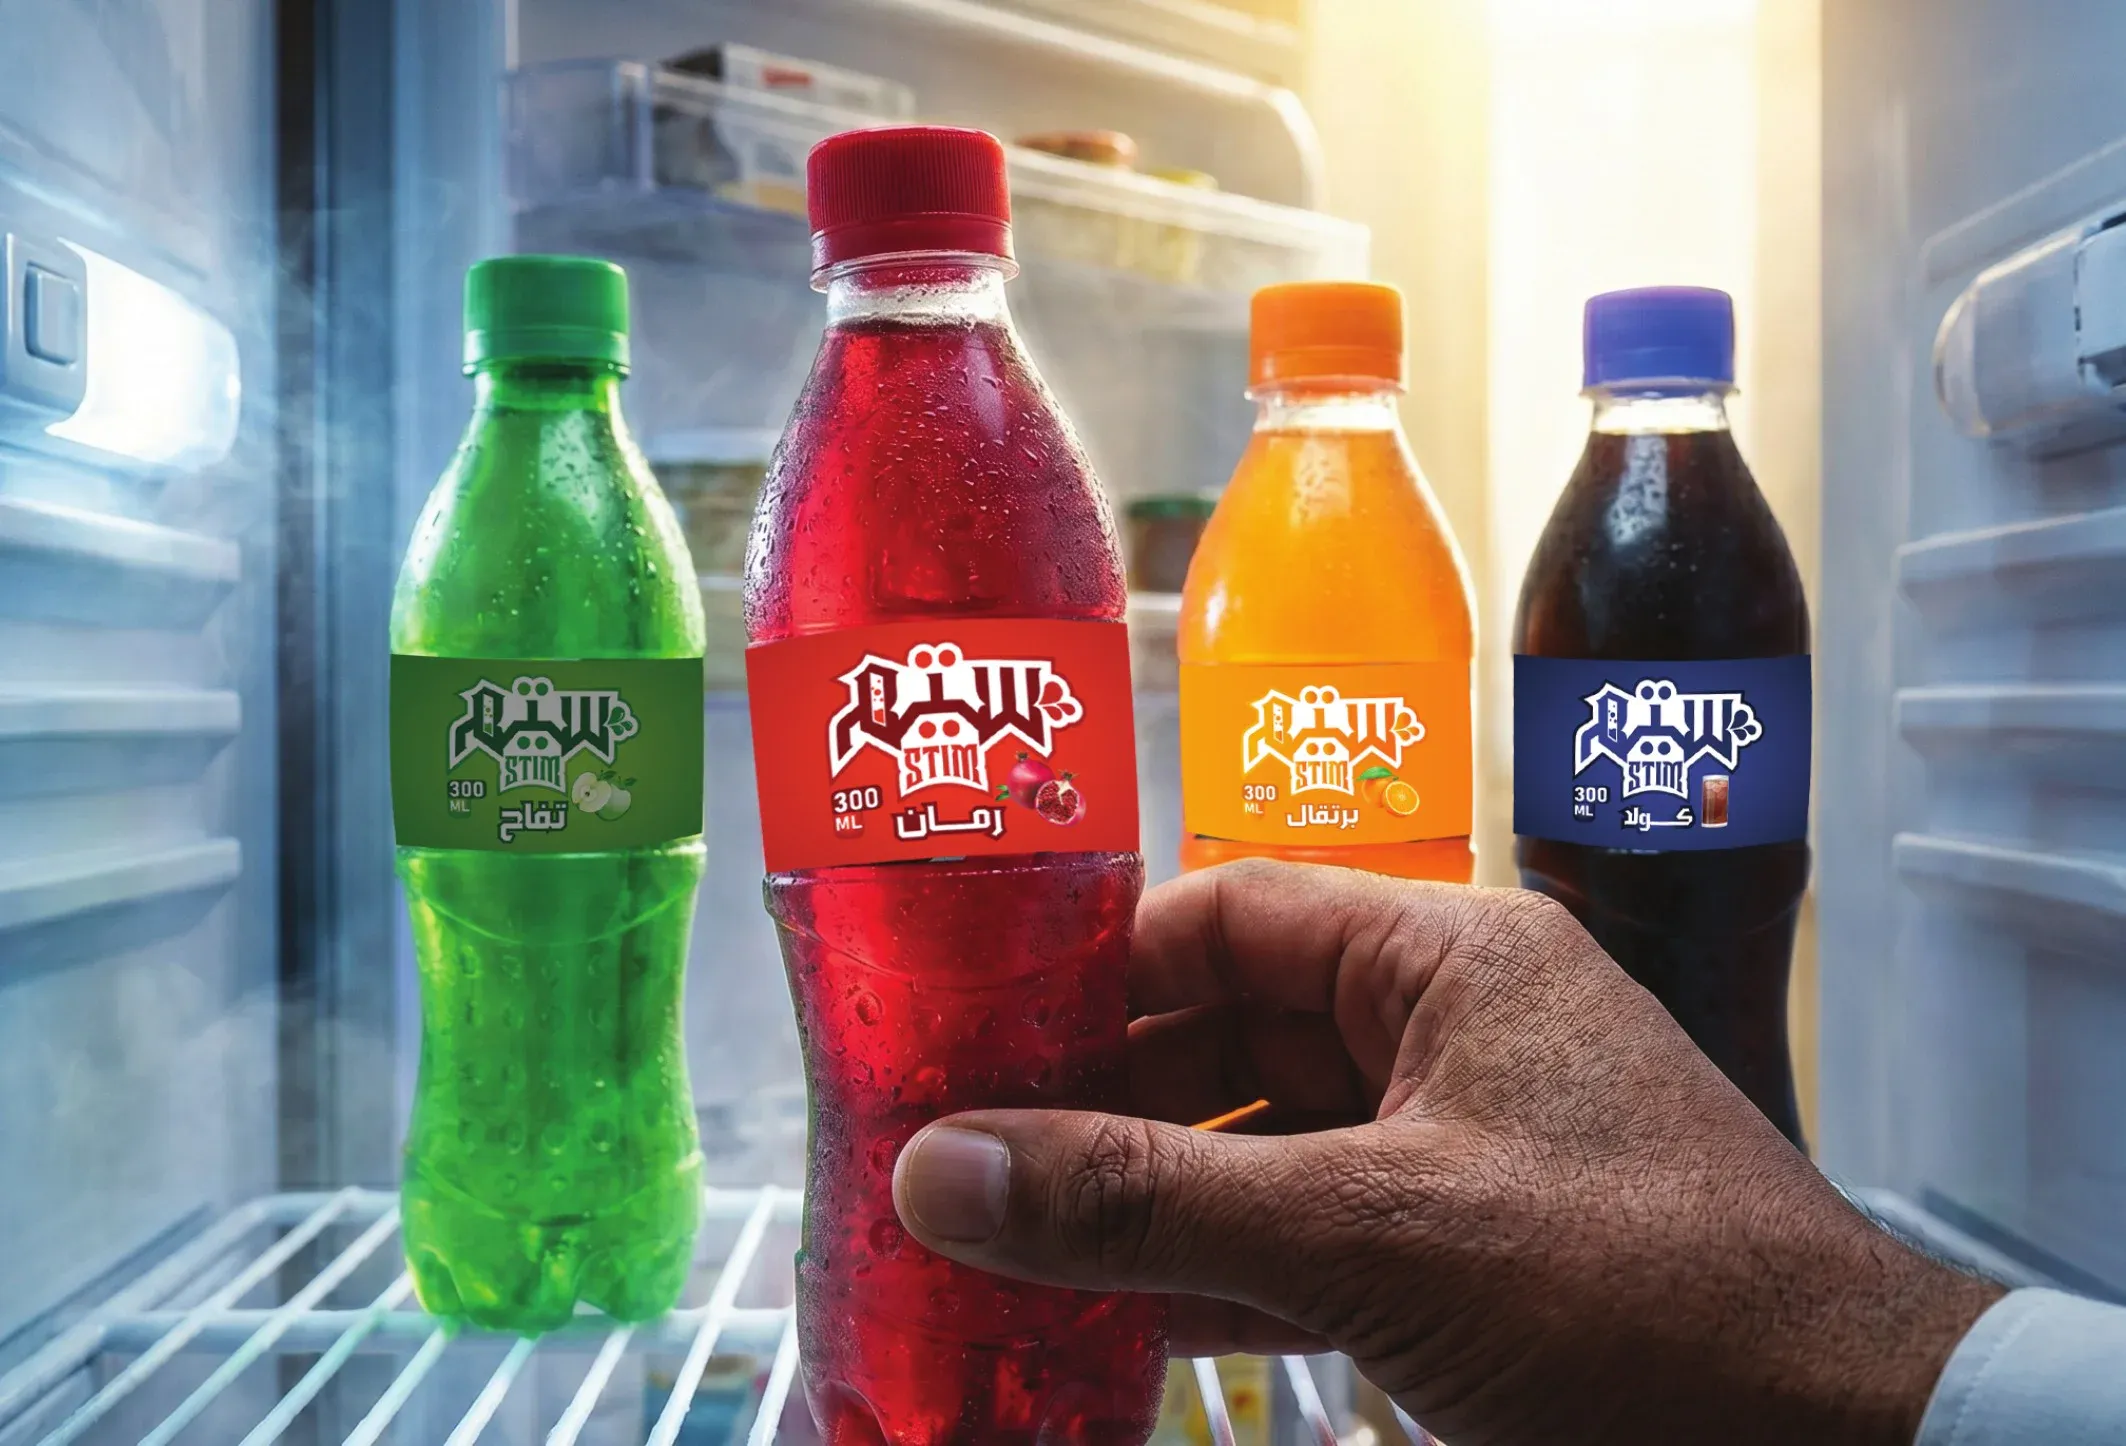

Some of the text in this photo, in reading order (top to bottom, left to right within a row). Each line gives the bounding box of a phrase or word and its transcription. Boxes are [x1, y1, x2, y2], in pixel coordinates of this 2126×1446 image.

[504, 755, 561, 786] STIM
[903, 743, 981, 787] STIM
[1296, 760, 1349, 790] STIM
[1627, 760, 1685, 794] STIM
[449, 781, 484, 798] 300
[834, 787, 879, 812] 300
[1244, 785, 1276, 801] 300
[1574, 787, 1608, 803] 300
[450, 801, 470, 813] ML
[1244, 803, 1264, 815] ML
[1286, 804, 1359, 829] برتقال
[1574, 805, 1594, 817] ML
[499, 802, 567, 842] تفاح
[835, 815, 863, 832] ML
